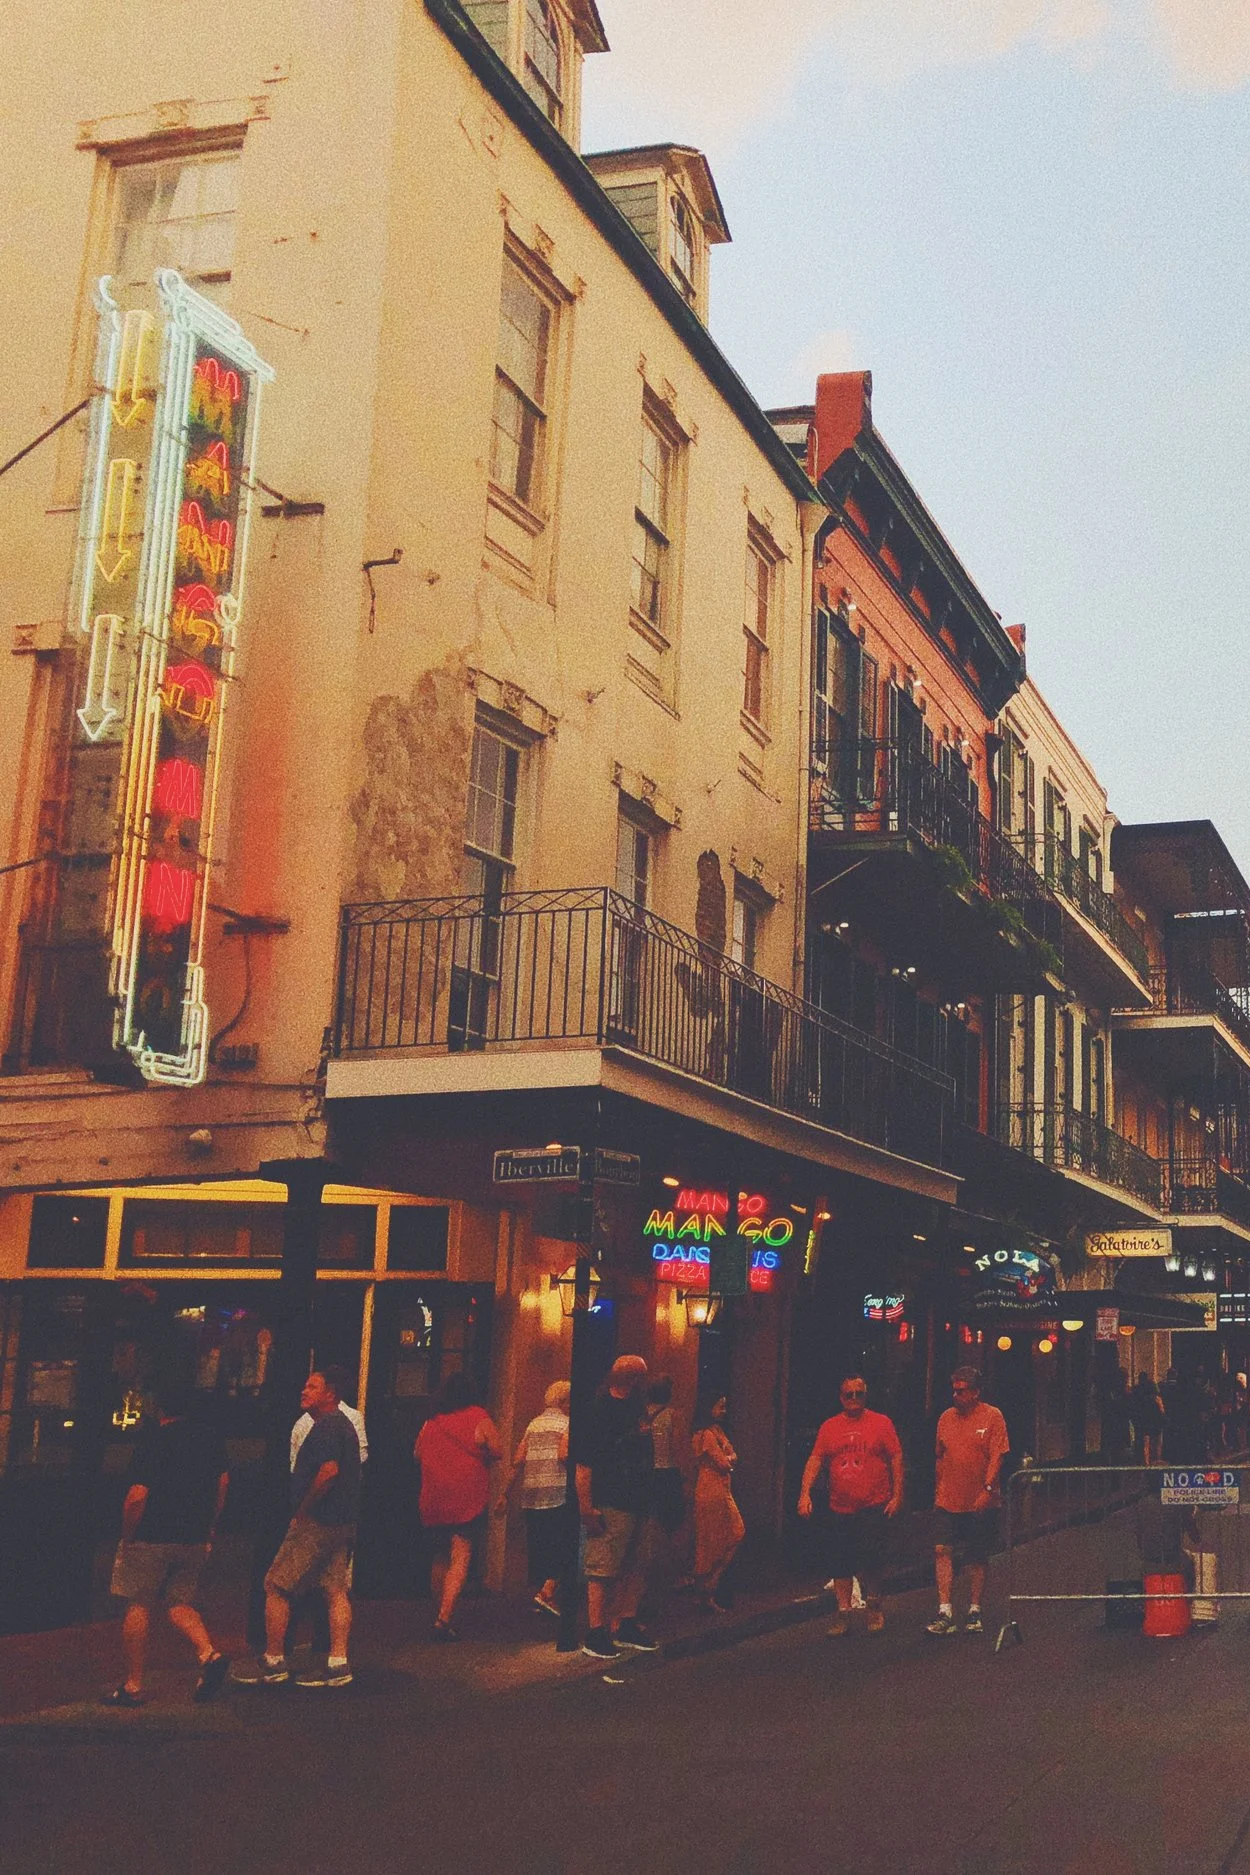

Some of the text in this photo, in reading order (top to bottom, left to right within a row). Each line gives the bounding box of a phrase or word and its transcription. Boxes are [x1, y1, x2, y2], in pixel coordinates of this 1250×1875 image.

[500, 1158, 574, 1177] Iberville
[643, 1209, 793, 1247] MANGO
[1090, 1235, 1164, 1253] Galatoire's
[652, 1243, 778, 1268] DAIQIS
[975, 1250, 1040, 1273] NOLA
[661, 1262, 707, 1280] PIZZA
